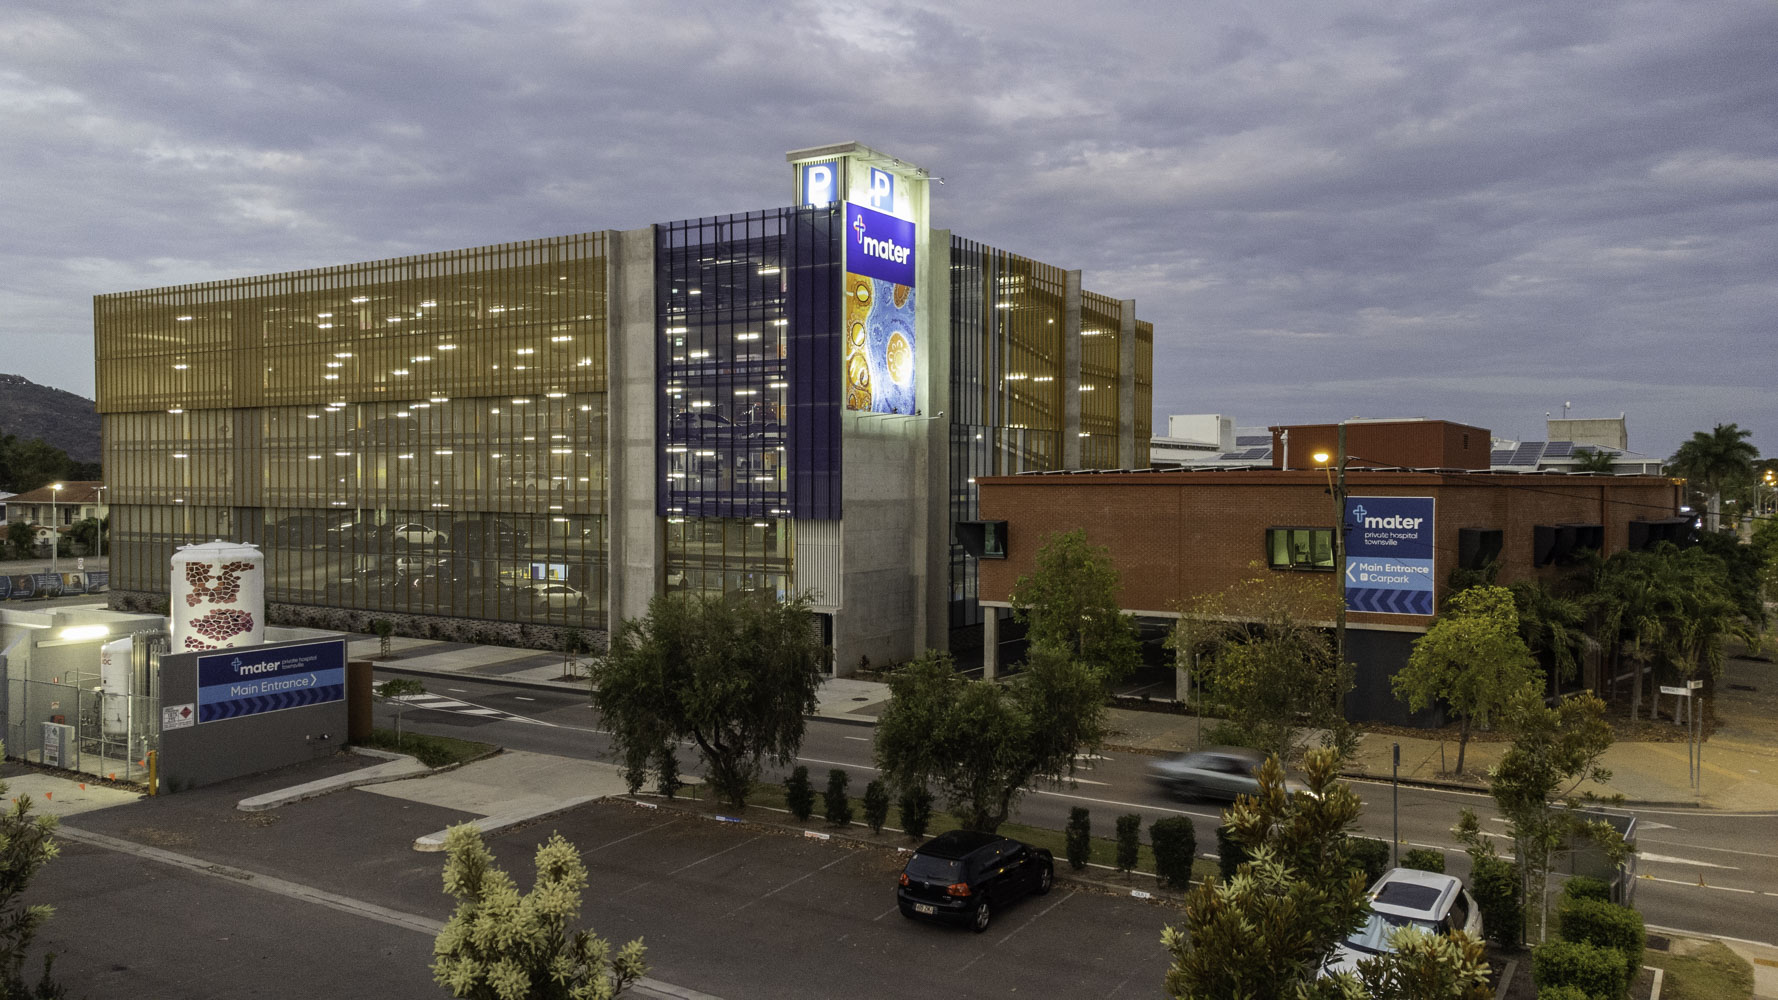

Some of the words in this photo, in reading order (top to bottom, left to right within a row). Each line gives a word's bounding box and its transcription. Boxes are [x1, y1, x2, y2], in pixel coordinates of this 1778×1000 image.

[808, 165, 832, 206] P
[874, 169, 891, 207] P
[863, 236, 911, 265] mater
[1365, 515, 1423, 529] mater
[1360, 563, 1383, 571] Main
[1385, 564, 1429, 573] Entrance
[1369, 573, 1409, 584] Carpark
[240, 661, 280, 675] mater
[230, 686, 259, 697] Main
[261, 678, 309, 693] Entrance
